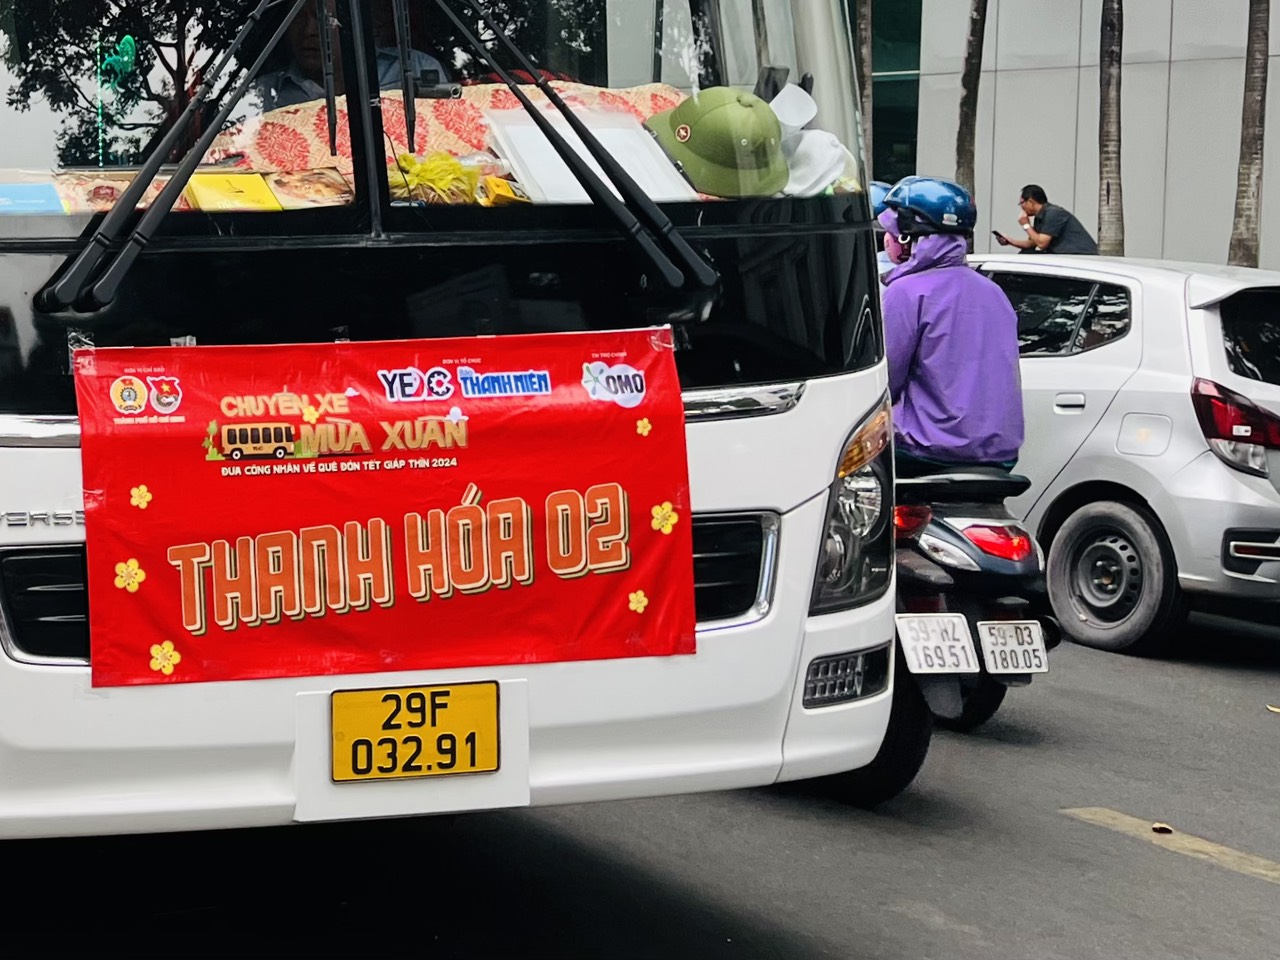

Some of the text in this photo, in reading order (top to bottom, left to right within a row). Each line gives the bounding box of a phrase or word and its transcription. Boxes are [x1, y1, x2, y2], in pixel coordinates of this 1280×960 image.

[461, 375, 513, 395] THANH
[605, 373, 644, 395] OMO
[314, 392, 350, 414] XE
[431, 457, 457, 467] 2024
[167, 482, 631, 636] THANH HÓA 02
[990, 648, 1043, 671] 180.05
[381, 690, 451, 730] 29F
[351, 731, 477, 775] 032.91
